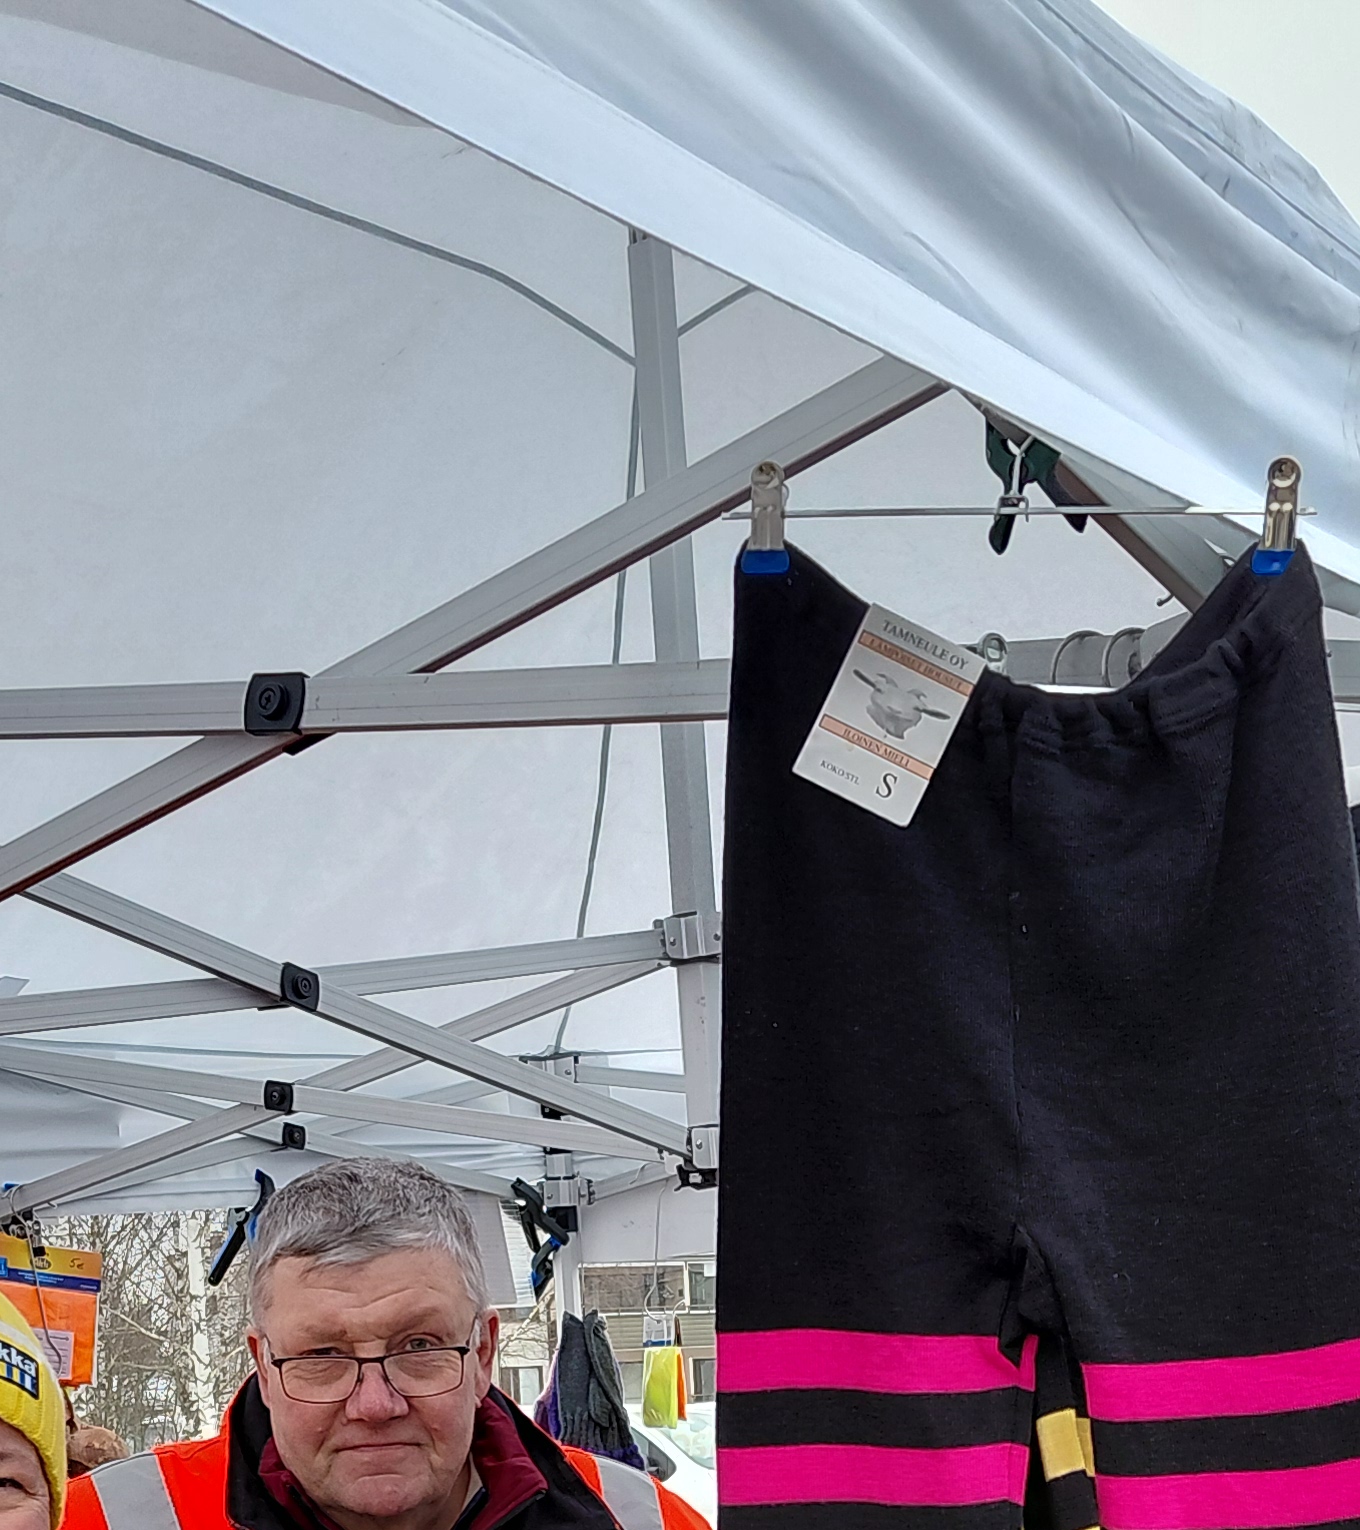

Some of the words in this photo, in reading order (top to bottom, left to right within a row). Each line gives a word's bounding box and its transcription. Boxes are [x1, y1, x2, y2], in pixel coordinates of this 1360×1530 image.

[882, 620, 949, 660] TAMNEULE
[948, 652, 969, 671] OY
[841, 727, 883, 752] ILOINEN
[880, 746, 911, 767] MIELI
[875, 773, 898, 798] S
